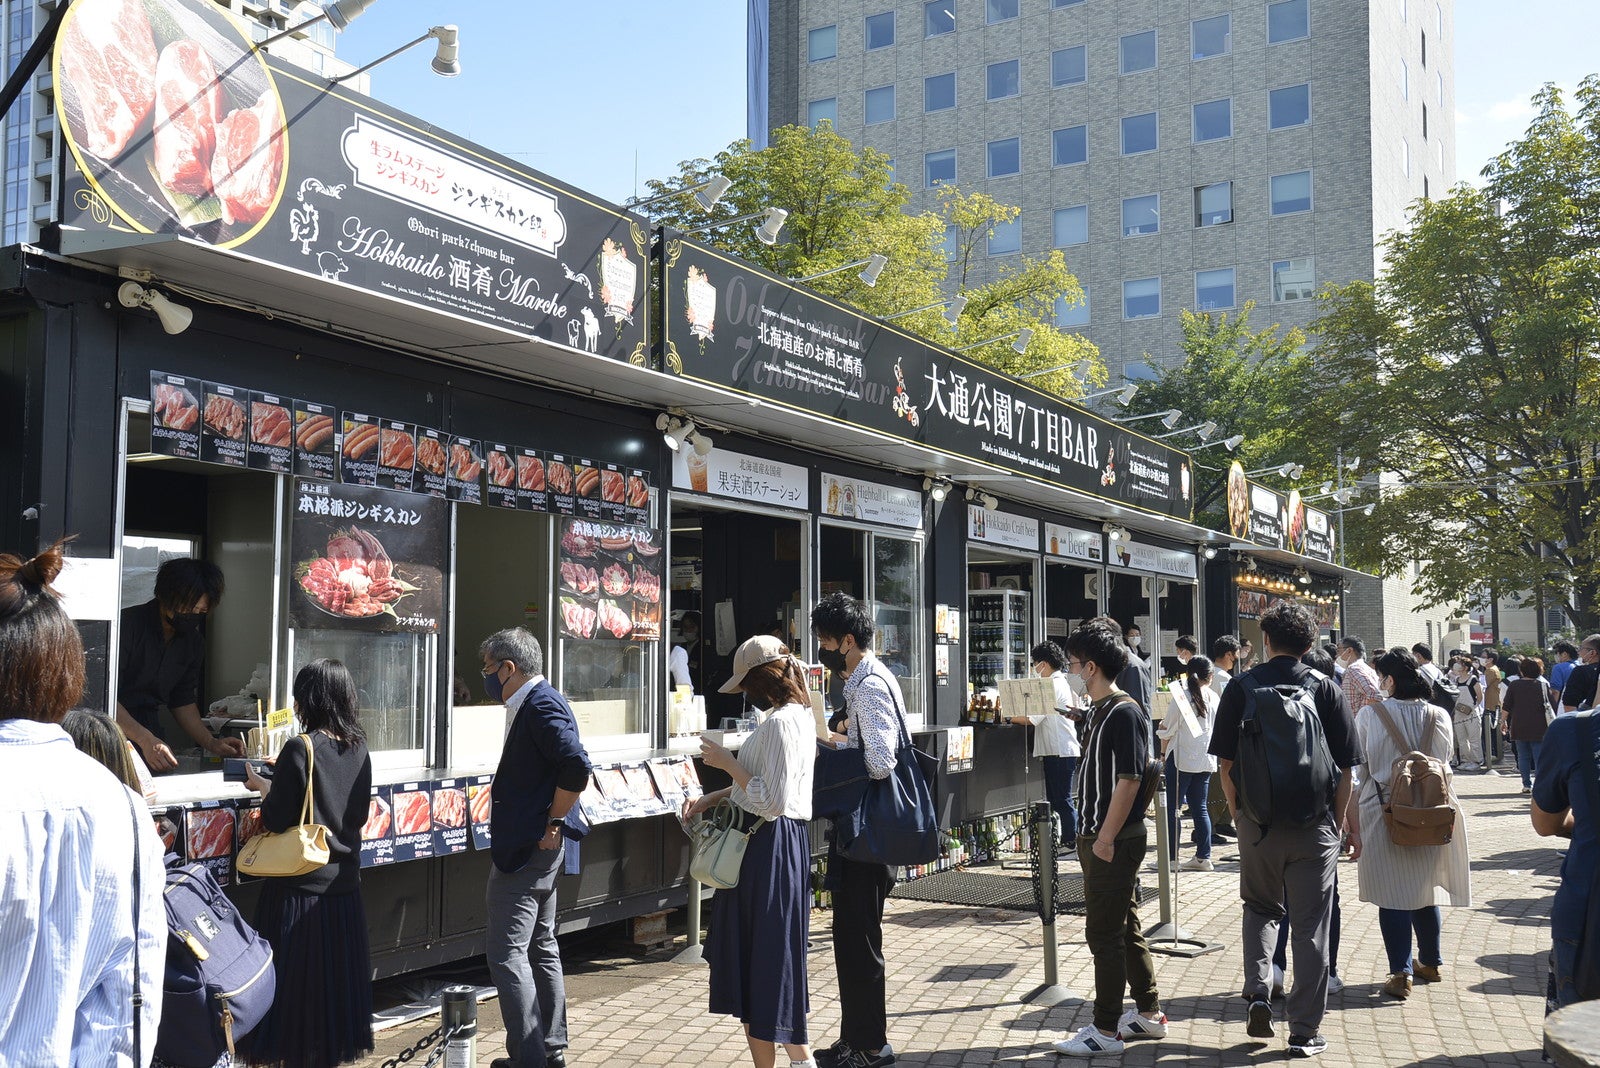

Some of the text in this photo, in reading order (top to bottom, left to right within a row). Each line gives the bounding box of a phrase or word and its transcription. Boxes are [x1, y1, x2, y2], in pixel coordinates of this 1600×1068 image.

[371, 140, 447, 179] 生ラムステージ
[376, 162, 440, 195] ジンギスカン
[408, 216, 439, 239] Odori
[500, 249, 515, 265] bar
[338, 216, 568, 318] Hokkaido 酒肴 Marche
[758, 322, 862, 378] 北海道産のお酒と酒肴
[806, 322, 821, 335] Odori
[821, 330, 832, 339] park
[848, 338, 860, 350] BAR
[924, 362, 1099, 470] 大通公園7丁目BAR
[981, 441, 993, 453] Made
[993, 445, 998, 454] in
[998, 447, 1018, 460] Hokkaido
[718, 471, 801, 501] 果実酒ステーション
[298, 494, 421, 525] 本格派ジンギスカン
[986, 514, 1010, 532] Hokkaido
[1012, 520, 1026, 535] Craft
[573, 520, 653, 543] 本格派ジンギスカン
[1068, 532, 1086, 556] Beer
